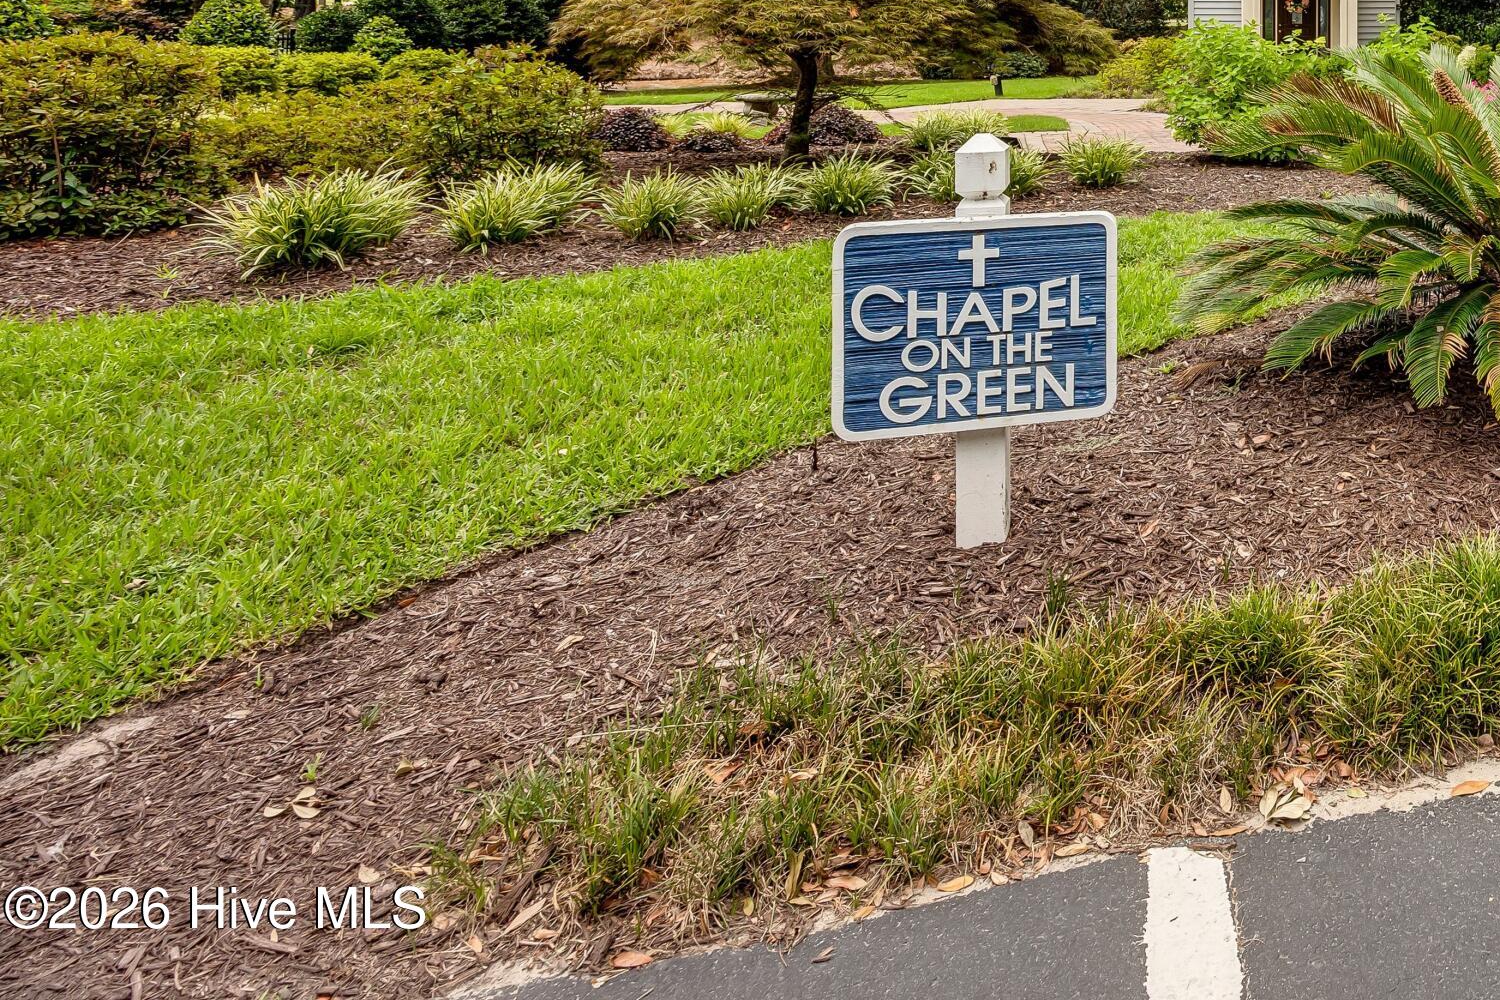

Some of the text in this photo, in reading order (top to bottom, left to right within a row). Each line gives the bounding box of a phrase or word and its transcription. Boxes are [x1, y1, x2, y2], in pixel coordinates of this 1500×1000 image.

[851, 274, 1097, 342] CHAPEL
[901, 331, 1053, 372] ON THE
[879, 363, 1075, 423] GREEN
